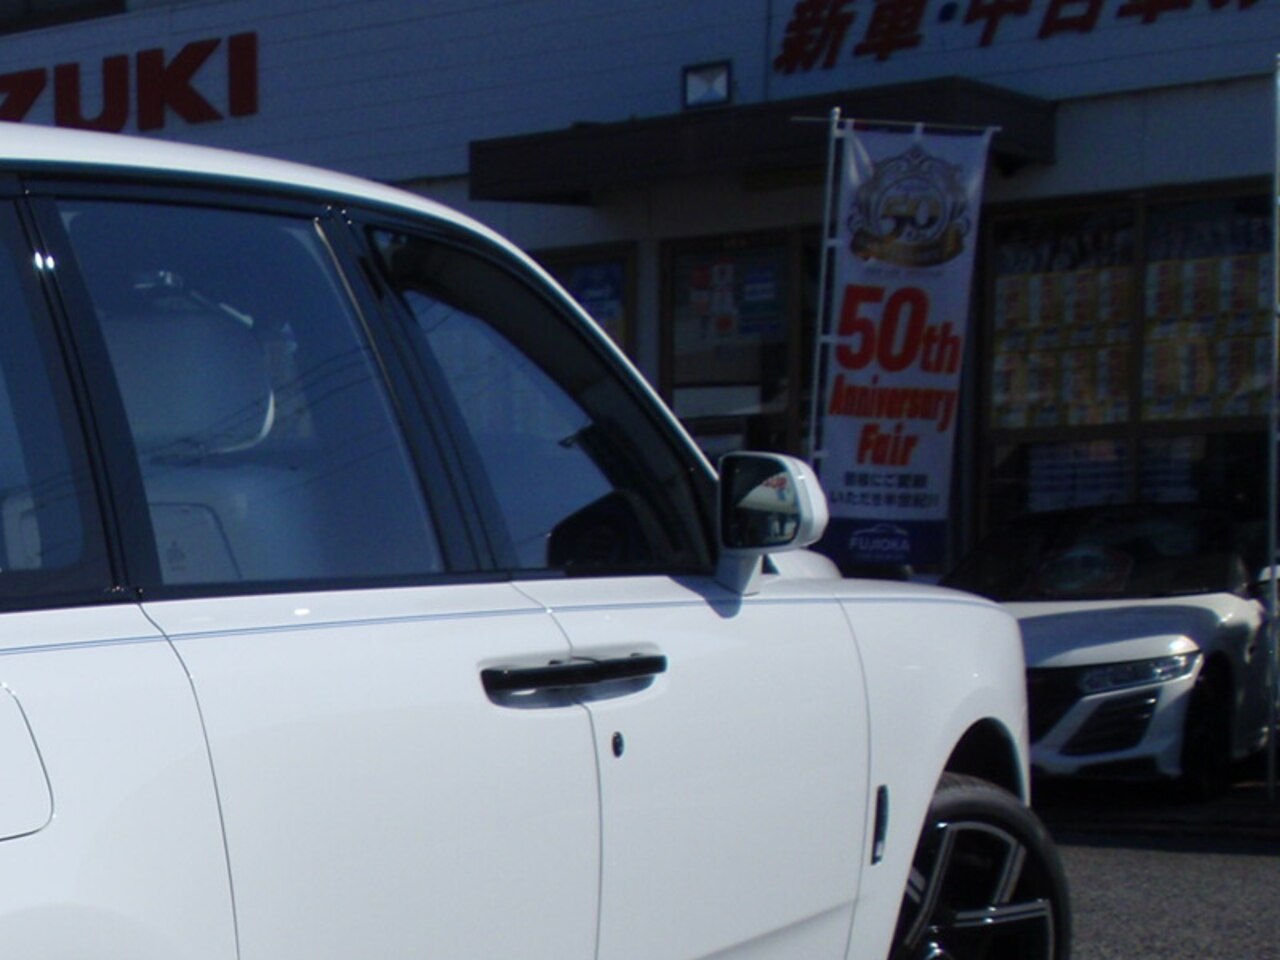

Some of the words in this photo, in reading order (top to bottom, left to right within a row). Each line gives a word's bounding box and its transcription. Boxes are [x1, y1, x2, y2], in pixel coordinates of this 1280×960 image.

[835, 285, 962, 375] 50th
[828, 374, 959, 433] Anniversary
[856, 422, 920, 466] Fair
